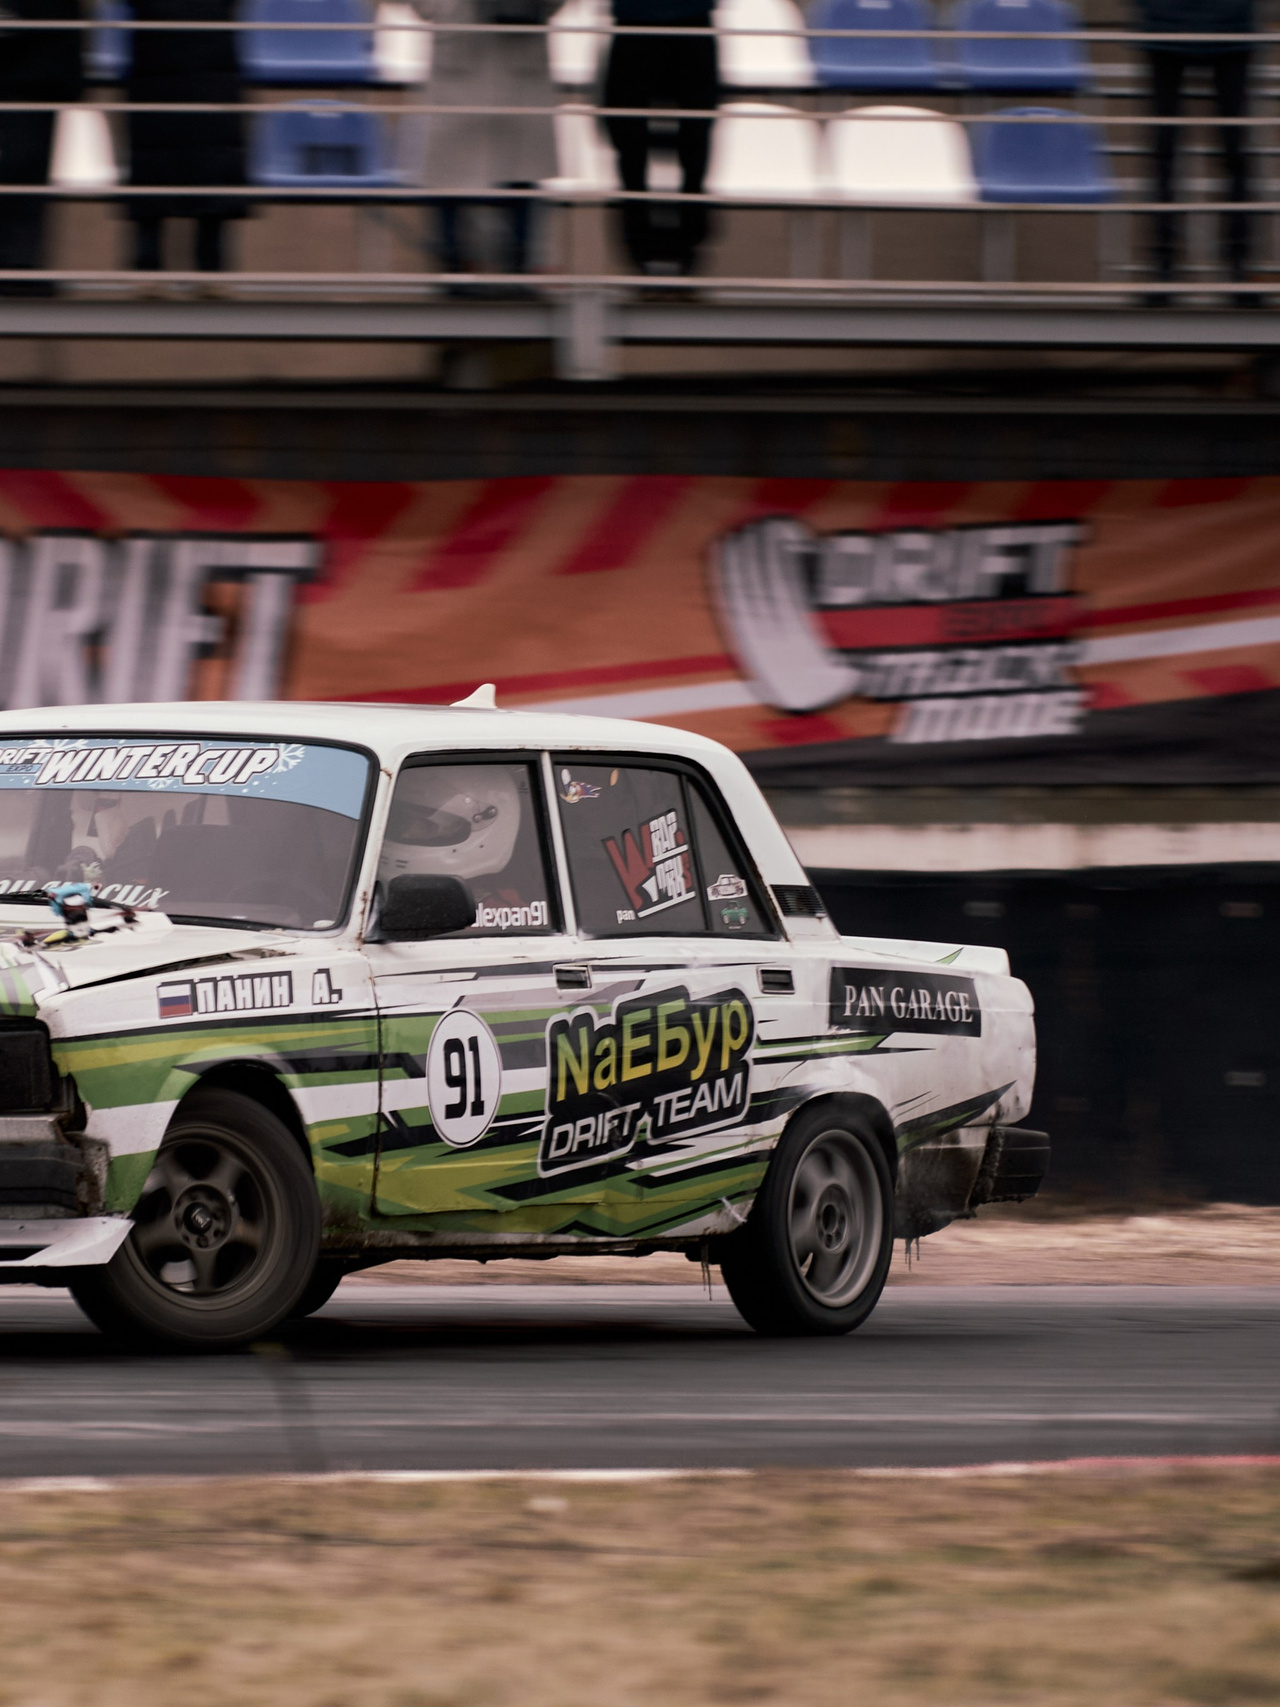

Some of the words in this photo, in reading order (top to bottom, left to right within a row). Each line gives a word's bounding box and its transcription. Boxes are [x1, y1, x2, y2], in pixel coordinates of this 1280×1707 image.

[812, 522, 1090, 604] DRIFT
[195, 970, 293, 1014] ПАНИН
[842, 983, 885, 1018] PAN
[890, 986, 973, 1023] GARAGE
[444, 1036, 486, 1121] 91
[548, 1101, 642, 1159] DRIFT
[653, 1071, 744, 1127] TEAM
